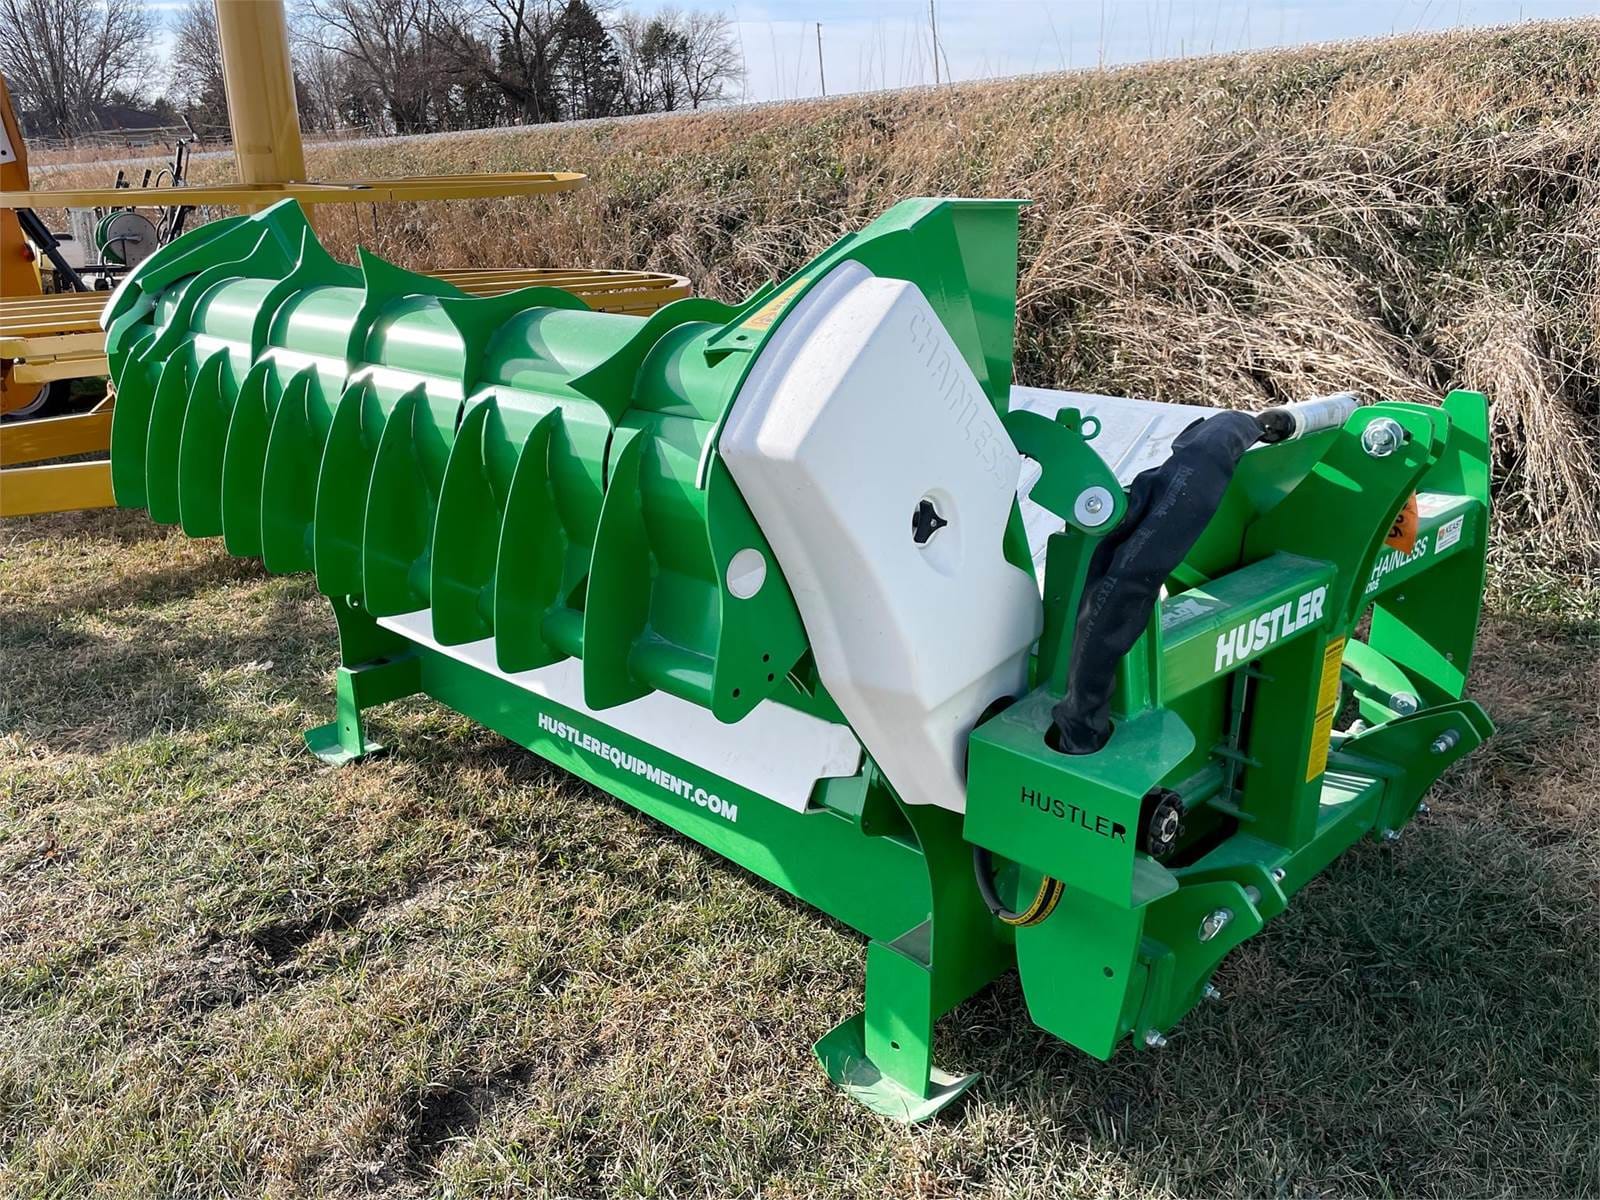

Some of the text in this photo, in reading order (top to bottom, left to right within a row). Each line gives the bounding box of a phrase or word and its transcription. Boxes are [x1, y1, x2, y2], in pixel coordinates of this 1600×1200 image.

[909, 304, 1013, 490] CHAINLESS
[1370, 535, 1428, 580] HAINLESS
[1215, 586, 1328, 672] HUSTLER
[538, 712, 738, 822] HUSTLEREQUIPMENT.COM
[1020, 786, 1126, 843] HUSTLER
